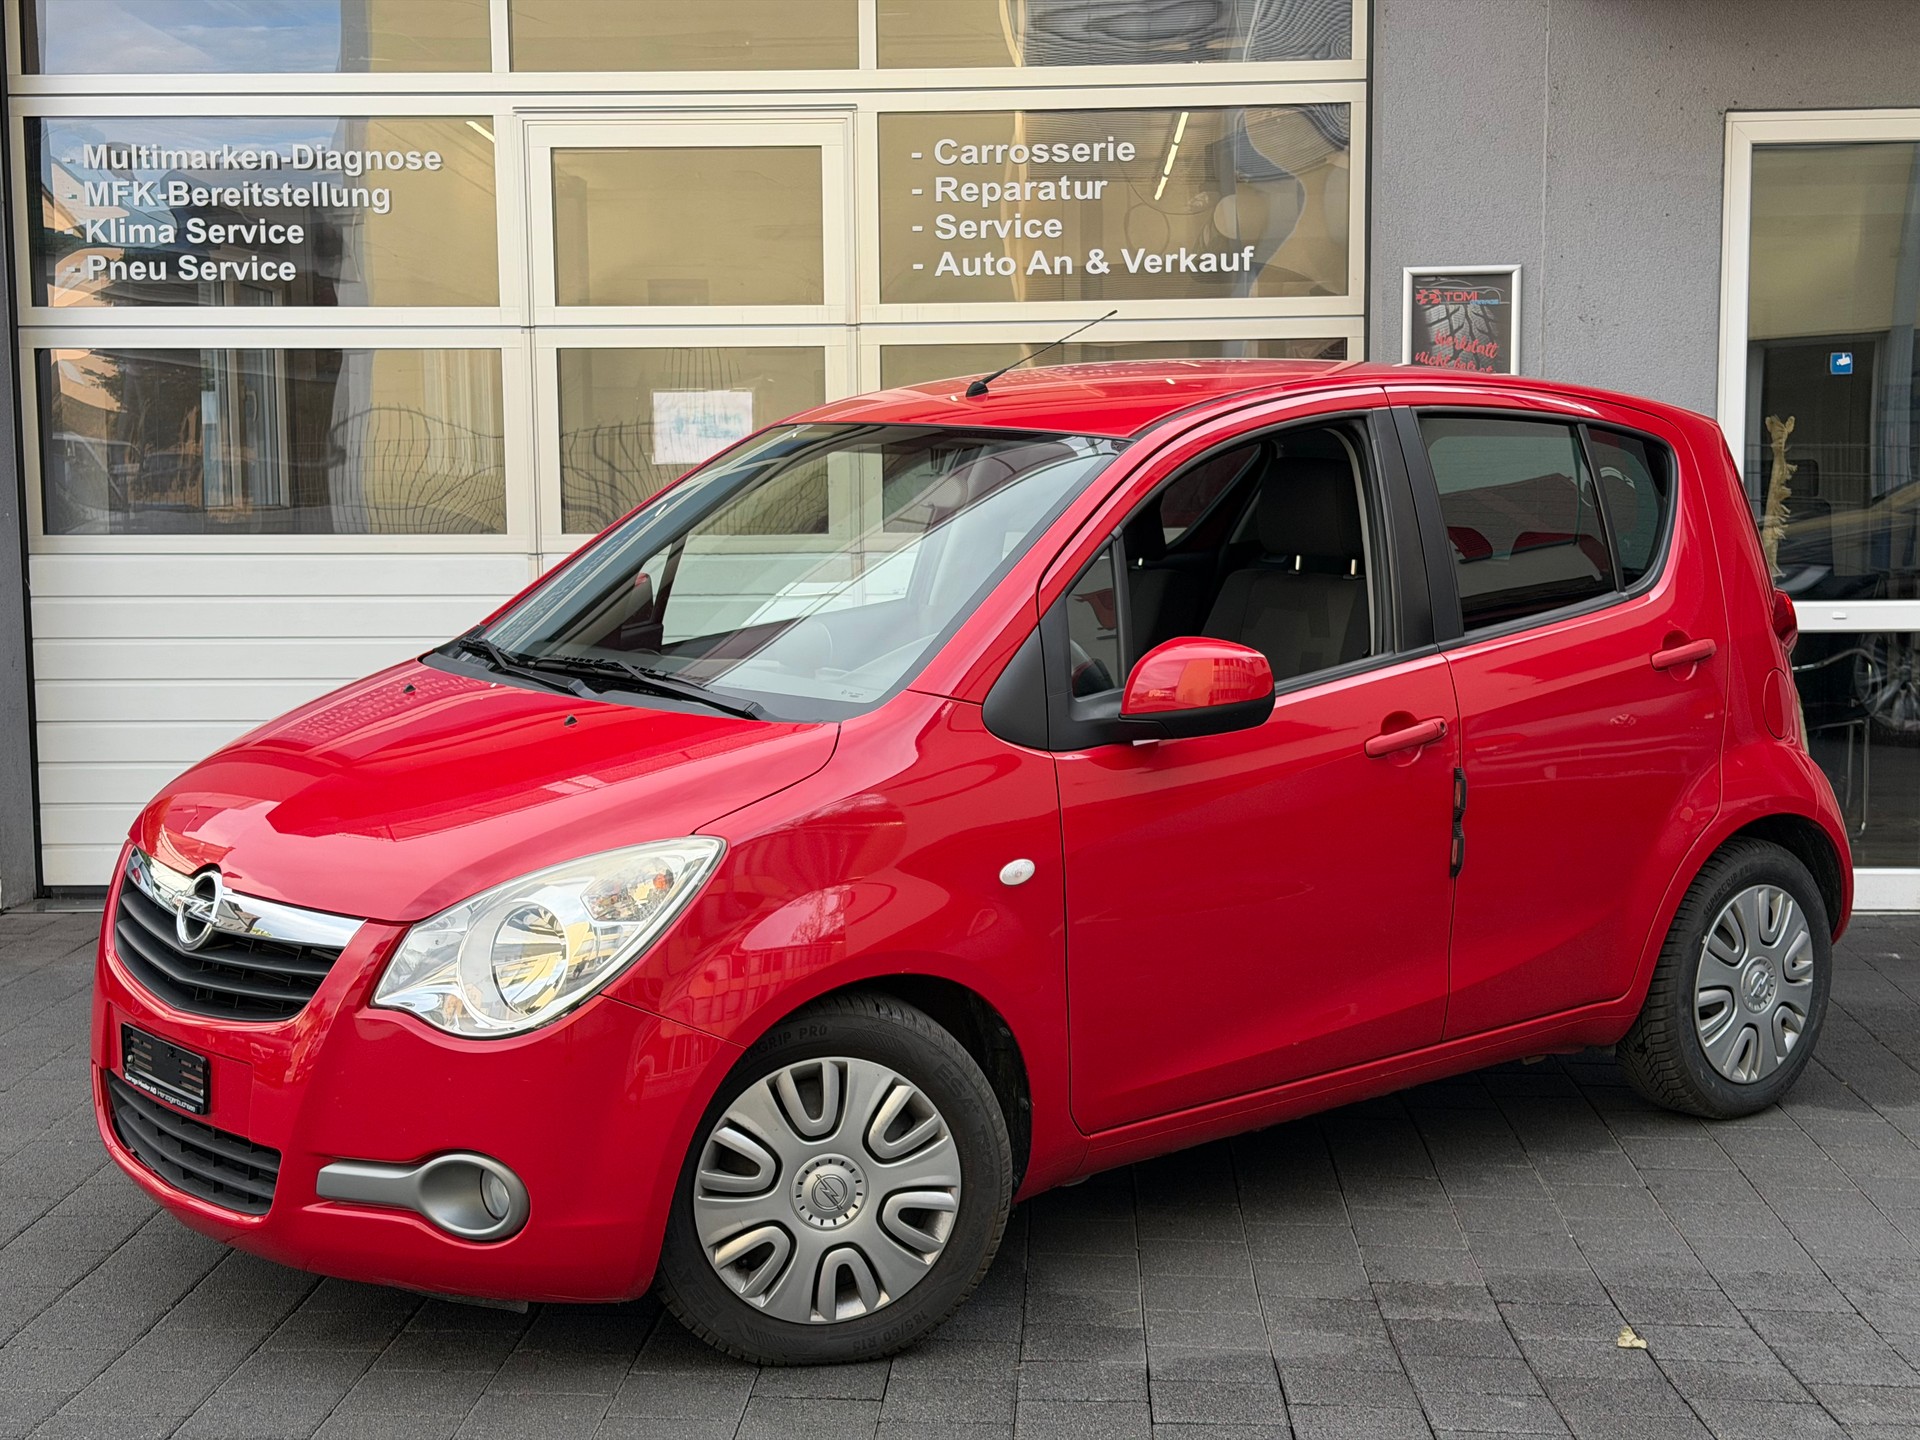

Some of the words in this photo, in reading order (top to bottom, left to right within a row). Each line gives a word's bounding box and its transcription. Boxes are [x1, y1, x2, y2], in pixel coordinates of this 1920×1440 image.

[82, 143, 442, 175] Multimarken-Diagnose
[934, 137, 1135, 165] Carrosserie
[84, 180, 391, 213] MFK-Bereitstellung
[935, 176, 1107, 207] Reparatur
[86, 218, 175, 244] Klima
[186, 218, 304, 244] Service
[935, 213, 1063, 240] Service
[87, 255, 167, 281] Pneu
[178, 255, 297, 281] Service
[935, 251, 1017, 276] Auto
[1026, 250, 1074, 275] An
[1085, 248, 1111, 275] &
[1121, 246, 1255, 274] Verkauf
[1444, 291, 1478, 301] TOMI
[1415, 351, 1450, 367] nicht
